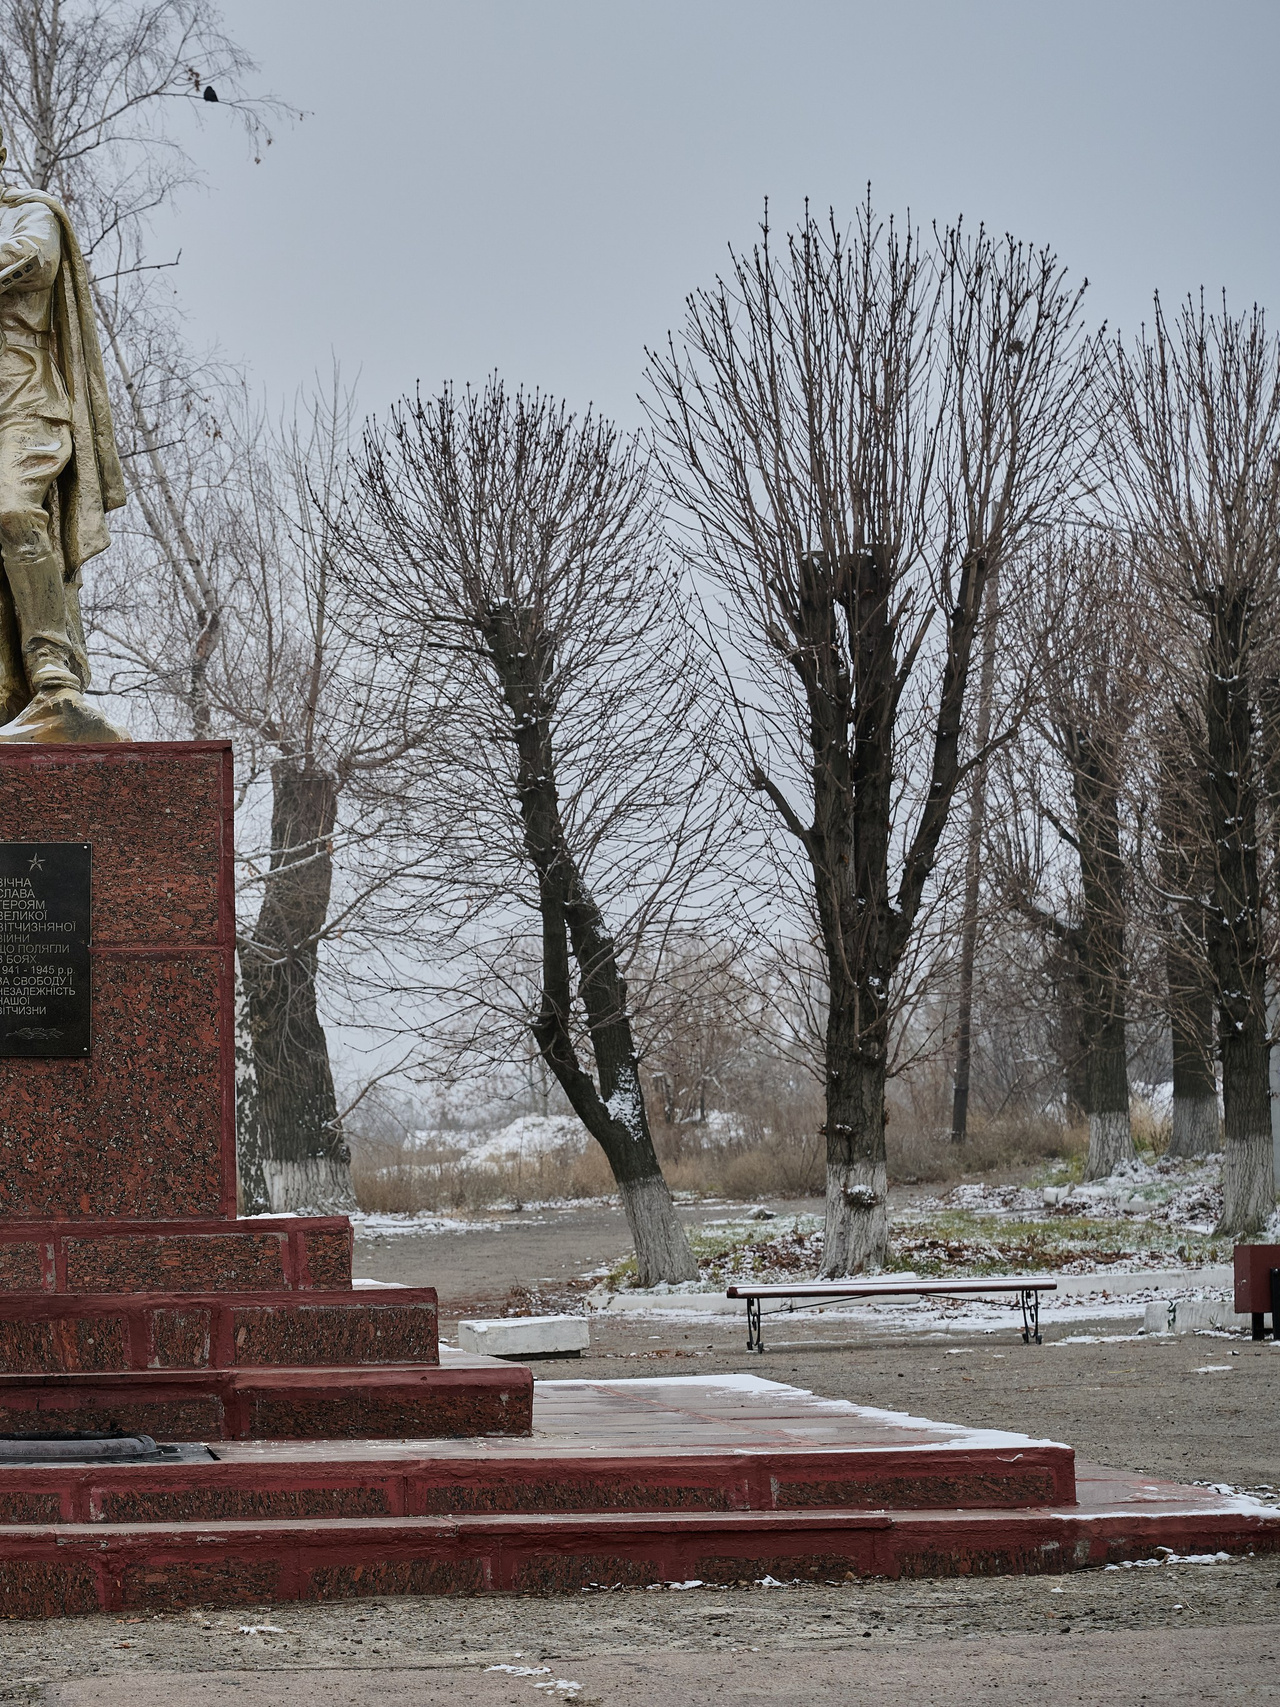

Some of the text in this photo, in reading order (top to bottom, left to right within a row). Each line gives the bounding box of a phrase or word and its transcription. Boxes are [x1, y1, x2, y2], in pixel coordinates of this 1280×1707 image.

[18, 944, 70, 954] ПОЛЯГЛИ
[31, 965, 55, 975] 1945
[13, 976, 67, 986] СВОБОДУ
